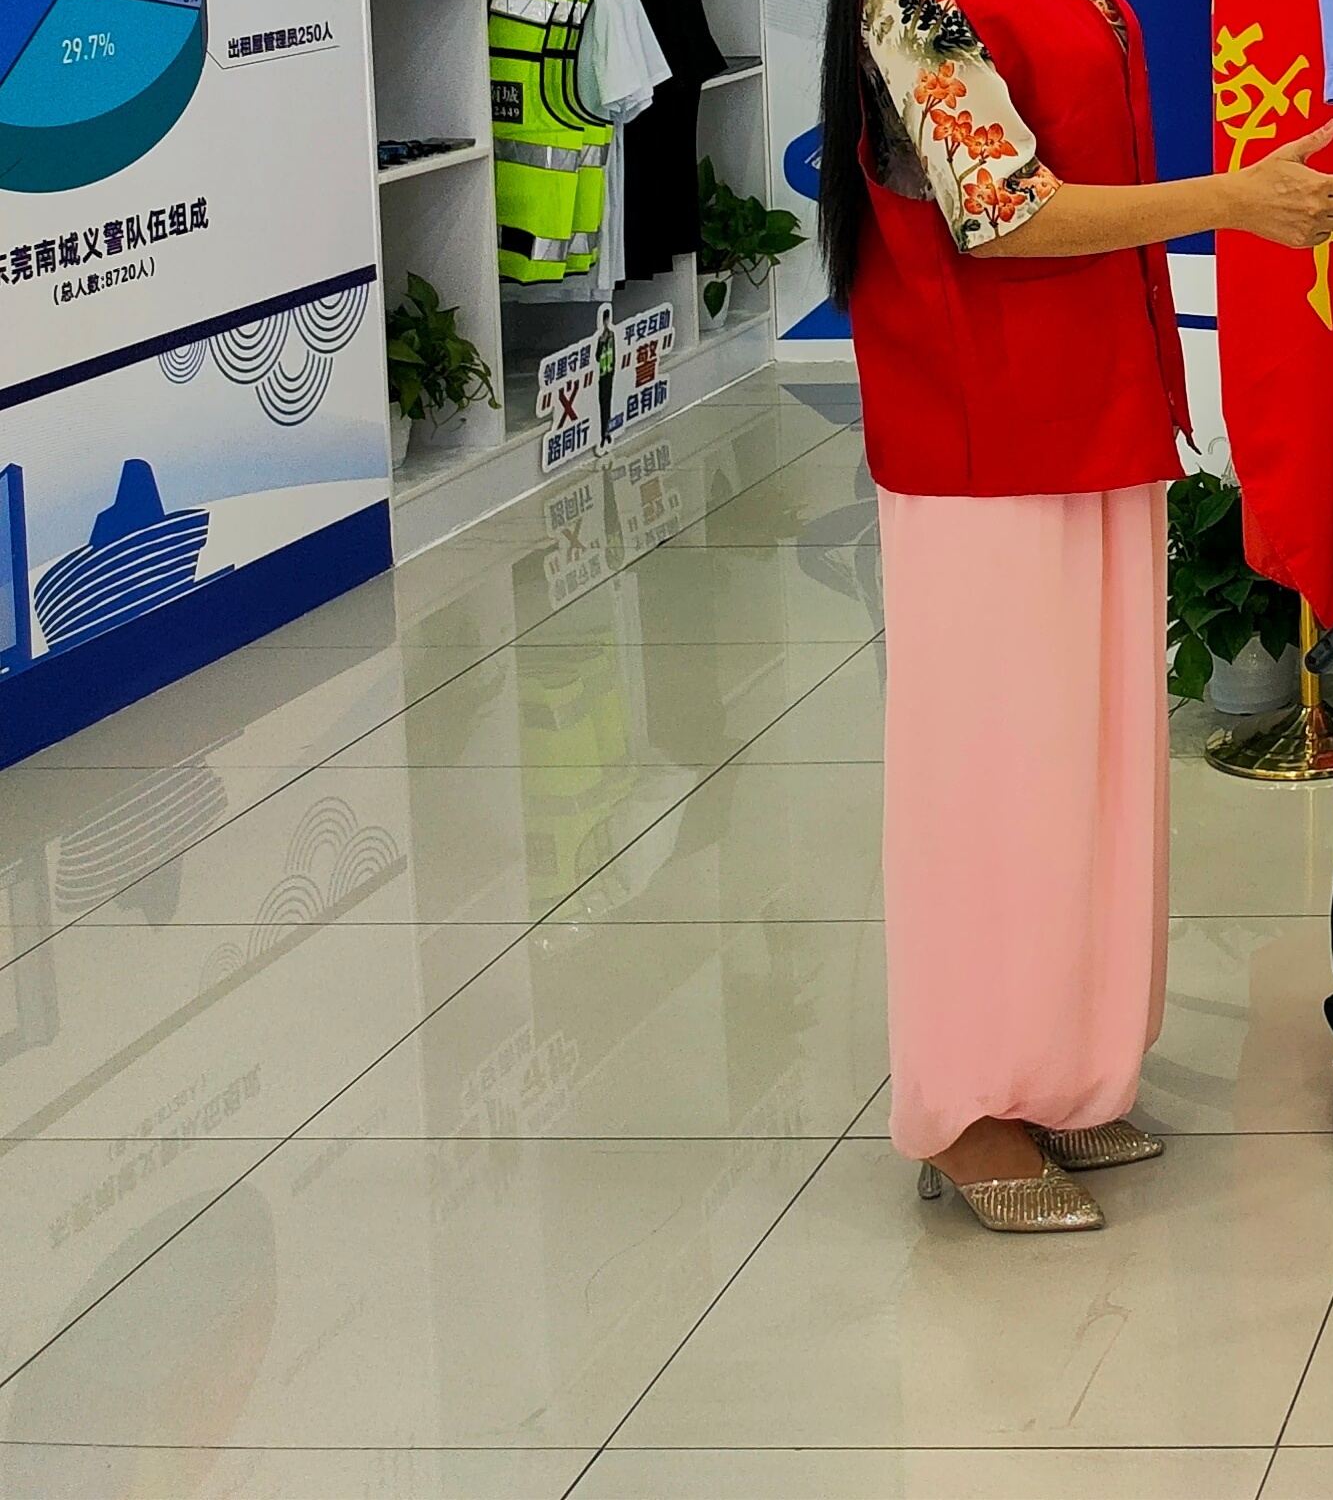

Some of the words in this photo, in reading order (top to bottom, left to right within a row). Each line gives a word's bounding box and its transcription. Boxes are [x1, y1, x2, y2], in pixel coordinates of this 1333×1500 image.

[62, 33, 115, 65] 29.7%
[227, 21, 334, 58] 出租屋管理员250人
[0, 197, 209, 286] 莞南城义警队伍组成
[623, 308, 671, 346] 平安互助
[544, 344, 591, 386] 邻里守望
[626, 379, 668, 421] 色有你
[547, 418, 590, 466] 路同行
